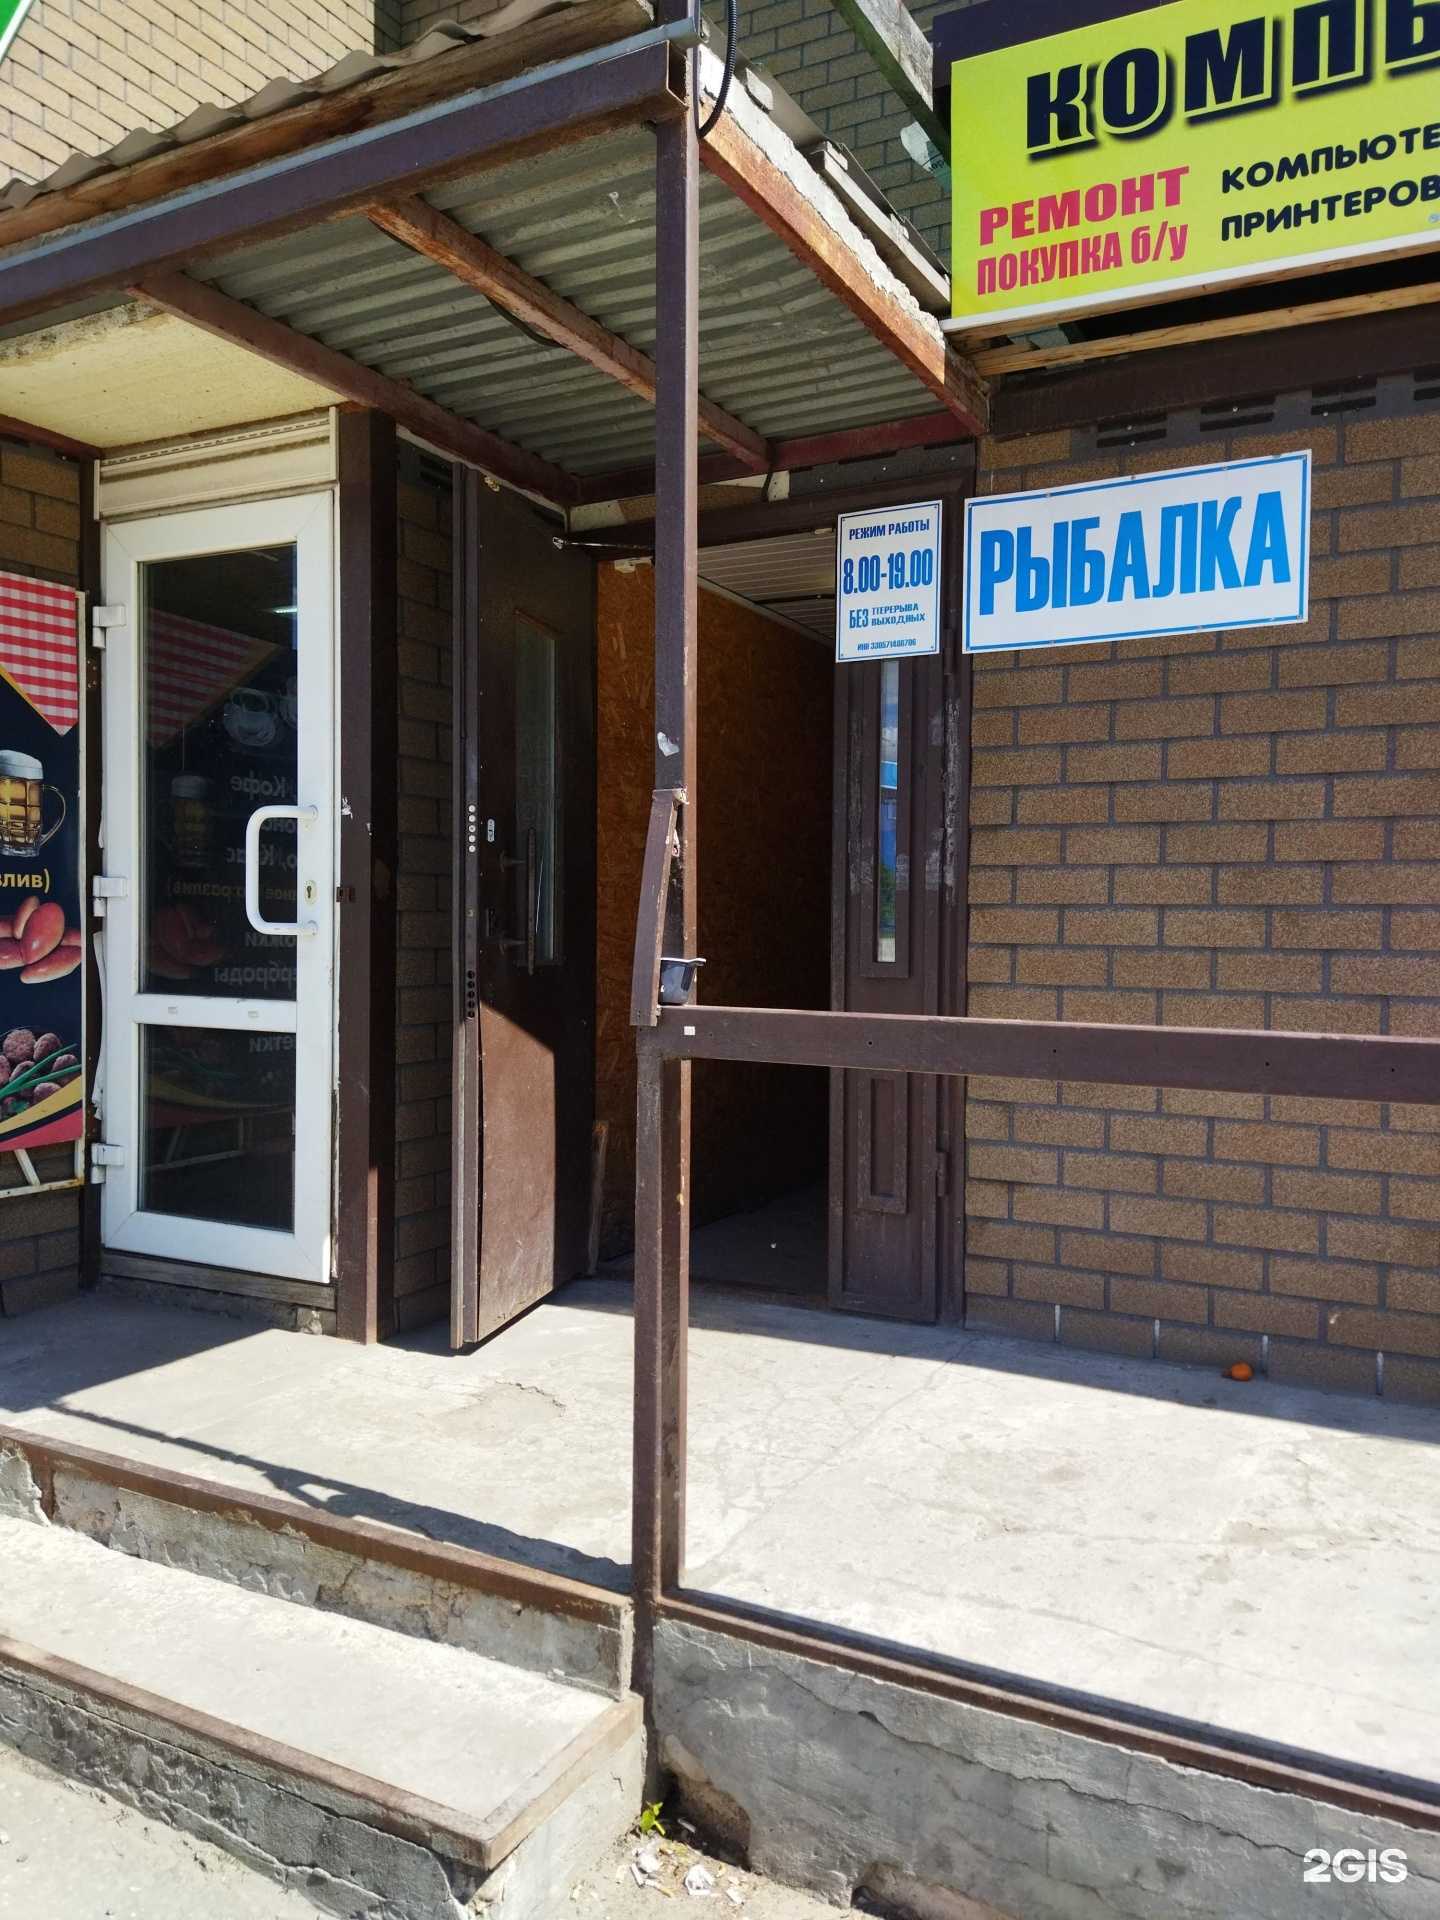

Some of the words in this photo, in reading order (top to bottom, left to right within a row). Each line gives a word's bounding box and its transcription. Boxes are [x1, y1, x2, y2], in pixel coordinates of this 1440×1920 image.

[1221, 122, 1440, 193] КОМПЬЮТЕ
[979, 166, 1190, 246] РЕМОНТ
[1221, 174, 1440, 241] ПРИНТЕРОВ
[977, 231, 1122, 296] ПОКУПКА
[1131, 221, 1189, 265] б/у
[849, 524, 886, 540] РЕЖИМ
[888, 518, 930, 536] РАБОТЫ
[979, 490, 1291, 616] РЫБАЛКА
[843, 548, 934, 595] 8.00-19.00
[849, 608, 869, 629] БЕЗ
[871, 603, 919, 616] ПЕРЕРЫВА
[871, 612, 926, 627] ВЫХОДНЫХ
